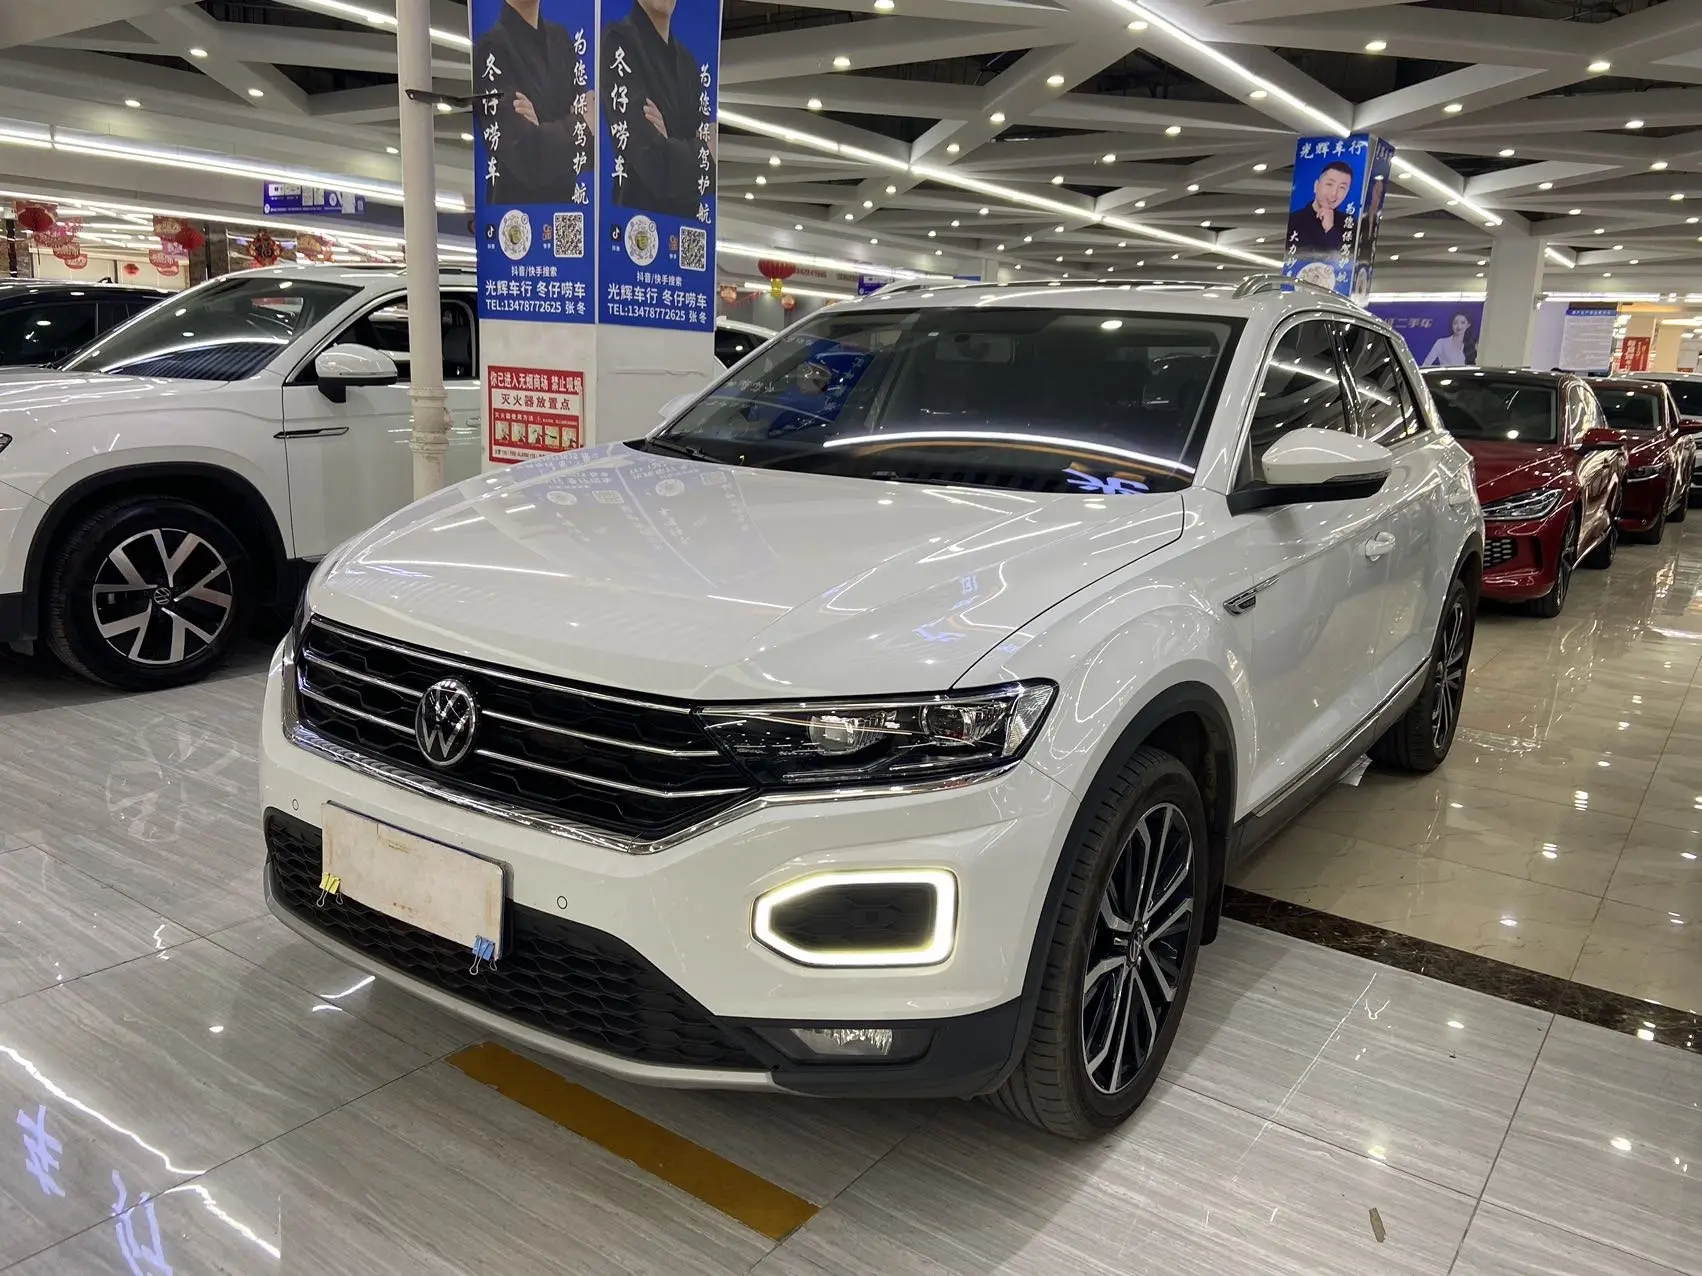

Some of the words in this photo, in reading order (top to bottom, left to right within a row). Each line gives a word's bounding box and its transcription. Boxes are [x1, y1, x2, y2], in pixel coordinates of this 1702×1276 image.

[571, 28, 590, 205] 为您保驾护航
[610, 46, 632, 187] 冬仔唠车
[696, 63, 712, 224] 为您保驾护航
[1300, 140, 1368, 159] 光辉车行
[511, 265, 557, 277] 抖音/快手搜索
[636, 270, 682, 287] 抖音/快手搜索
[485, 280, 532, 297] 光辉车行
[536, 281, 586, 299] 冬仔唠车
[607, 283, 658, 304] 光辉车行
[662, 289, 707, 309] 冬仔唠车
[486, 299, 562, 313] TEL:13478772625
[607, 303, 686, 321] TEL:13478772625
[500, 393, 571, 411] 灭火器放置点
